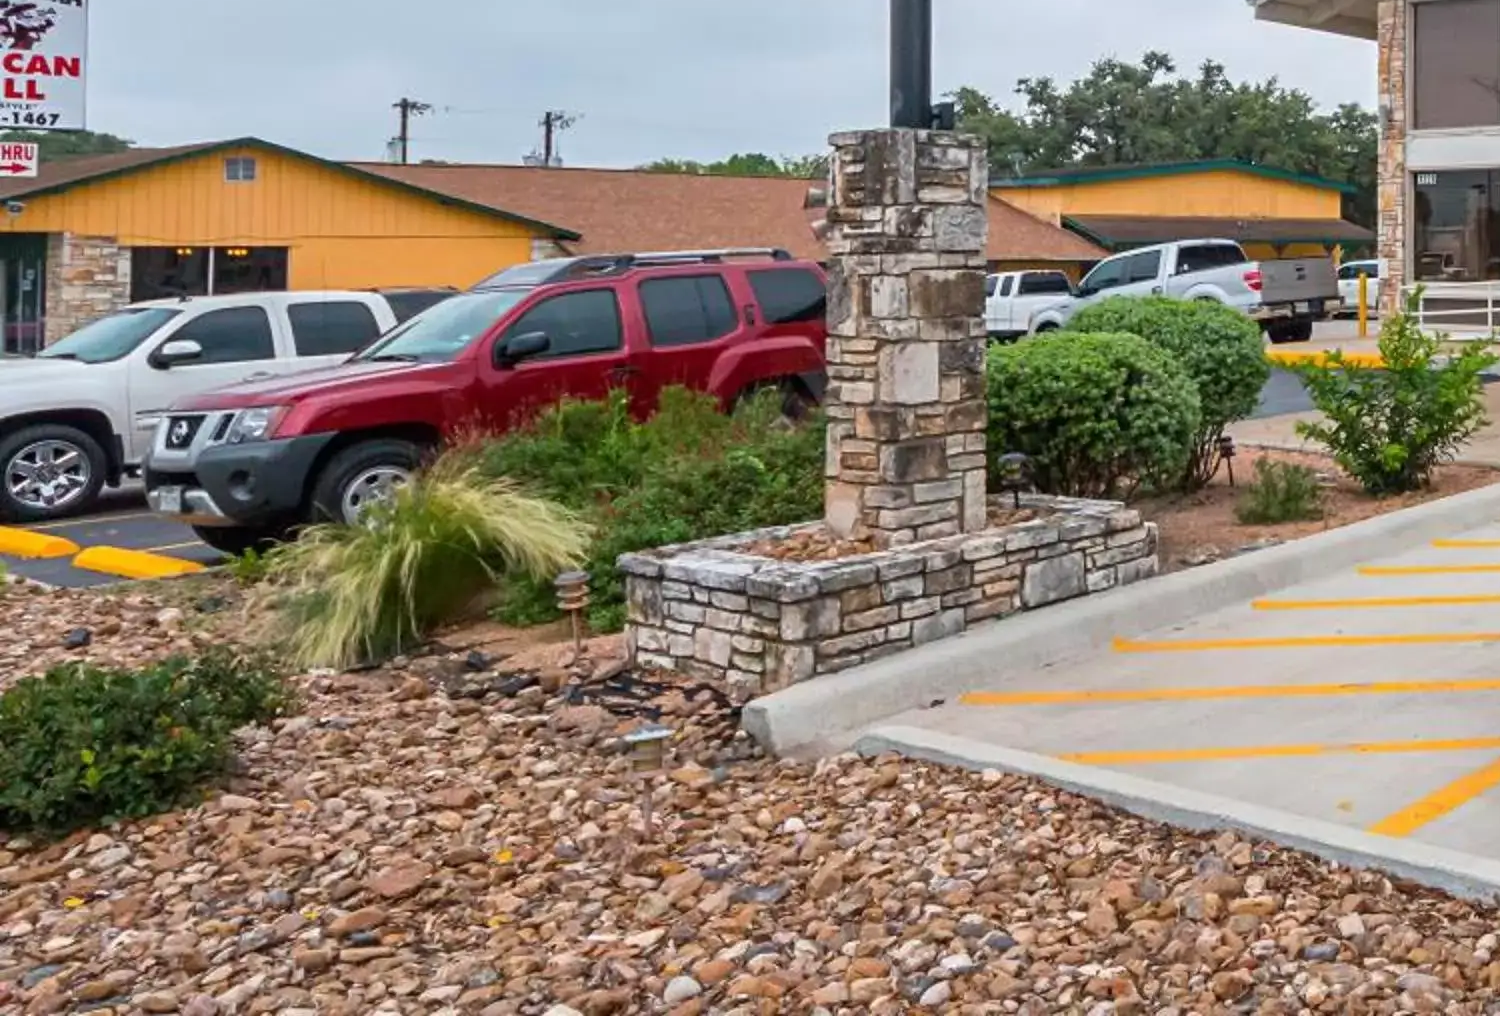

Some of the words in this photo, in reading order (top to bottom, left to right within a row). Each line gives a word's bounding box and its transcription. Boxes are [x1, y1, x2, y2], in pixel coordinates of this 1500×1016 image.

[3, 53, 80, 77] CAN
[4, 78, 45, 100] LL
[2, 112, 60, 126] -1467
